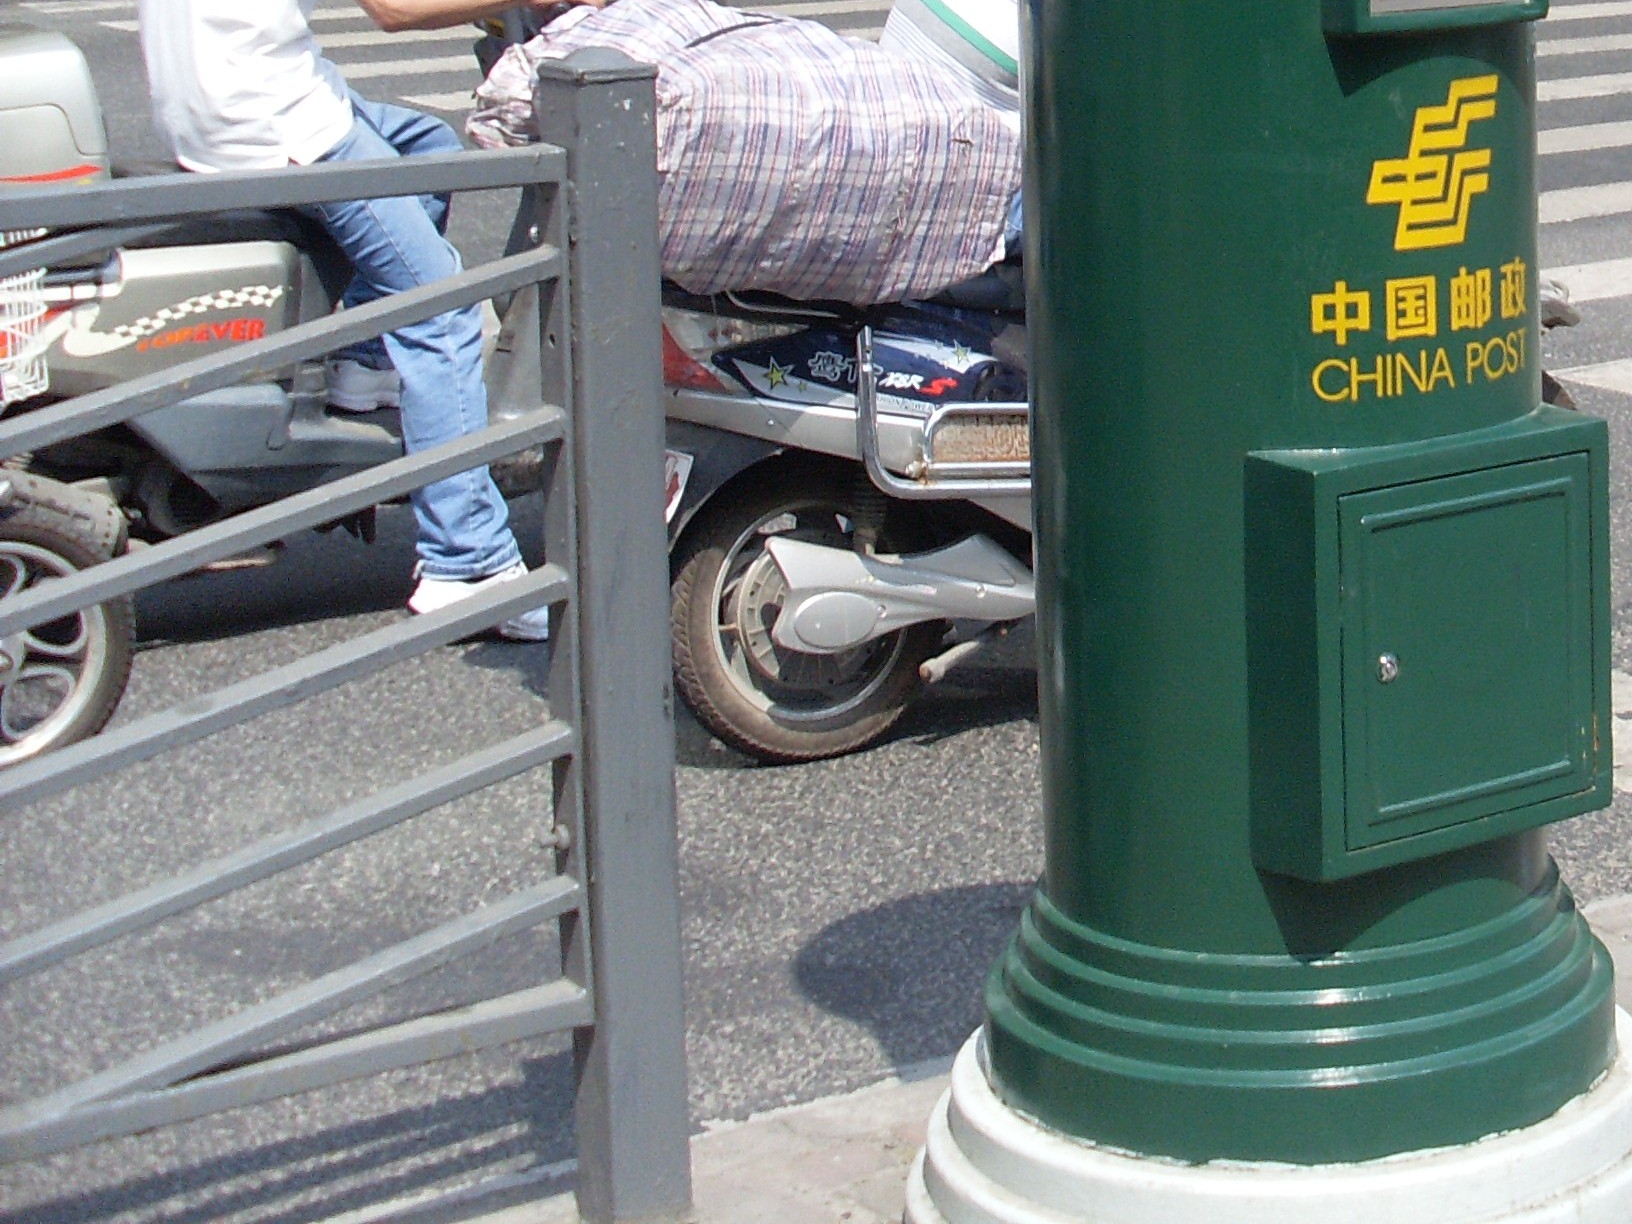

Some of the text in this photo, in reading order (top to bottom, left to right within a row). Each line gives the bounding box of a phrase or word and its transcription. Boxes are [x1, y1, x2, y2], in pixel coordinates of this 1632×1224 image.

[1311, 257, 1527, 346] 中国邮政
[1311, 327, 1528, 403] CHINA POST
